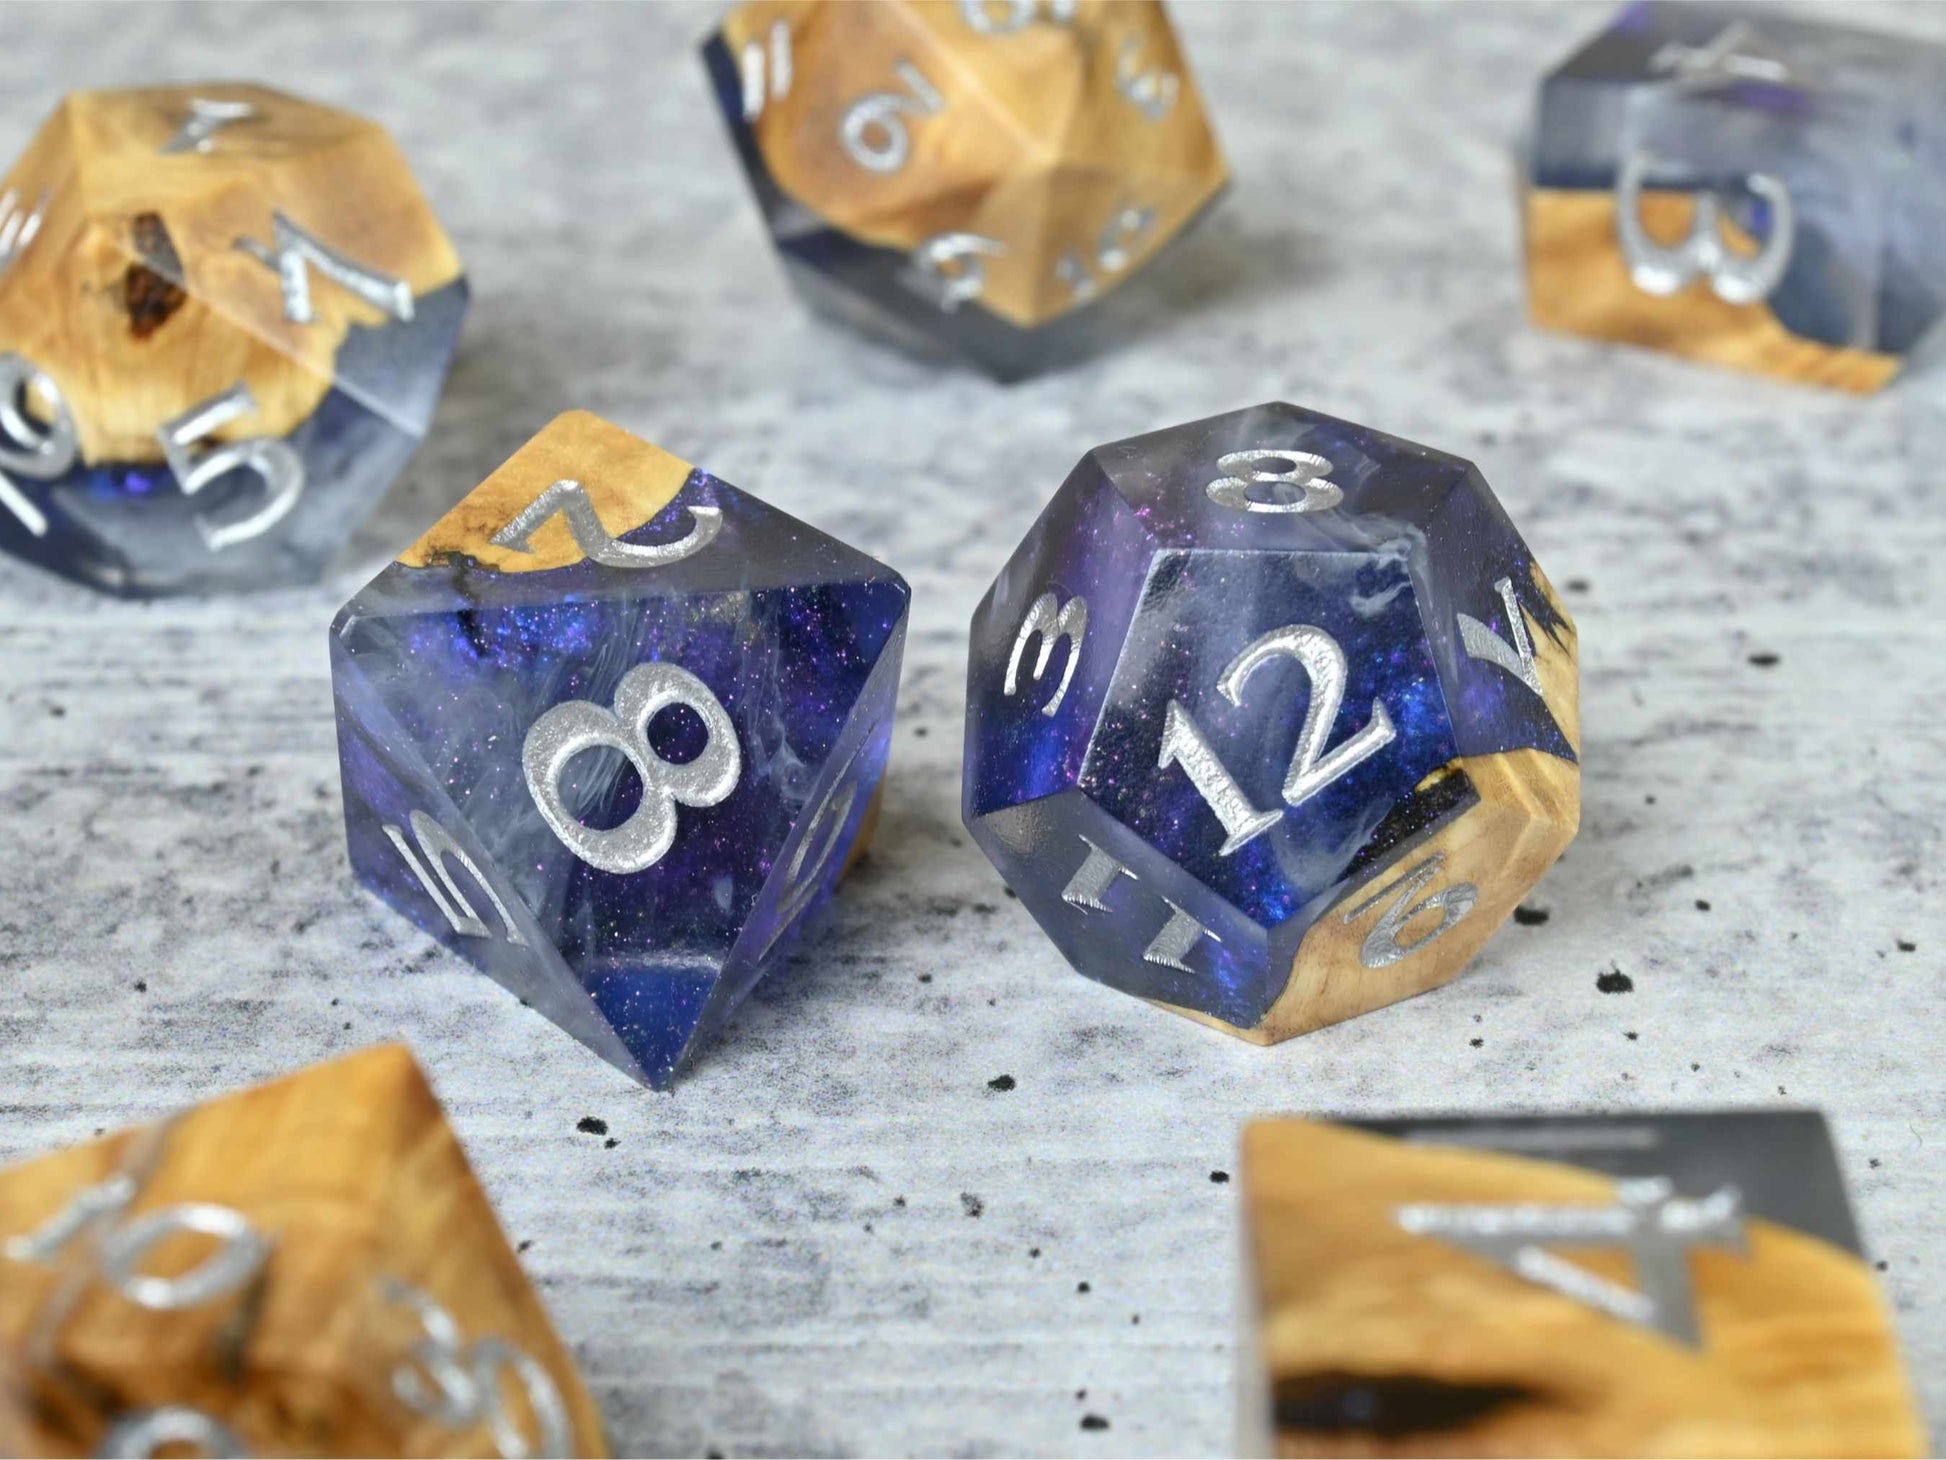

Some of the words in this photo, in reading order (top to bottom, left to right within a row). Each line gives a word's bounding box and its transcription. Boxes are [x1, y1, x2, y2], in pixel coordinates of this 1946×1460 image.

[157, 379, 305, 550] 5
[489, 479, 724, 568] 2
[1205, 449, 1345, 514] 8
[1003, 592, 1089, 717] 3
[1456, 576, 1544, 696] 7
[521, 661, 742, 875] 8
[1157, 623, 1398, 857] 12
[382, 808, 529, 947] 5
[1060, 833, 1222, 975] 11
[1395, 1173, 1752, 1357] 4
